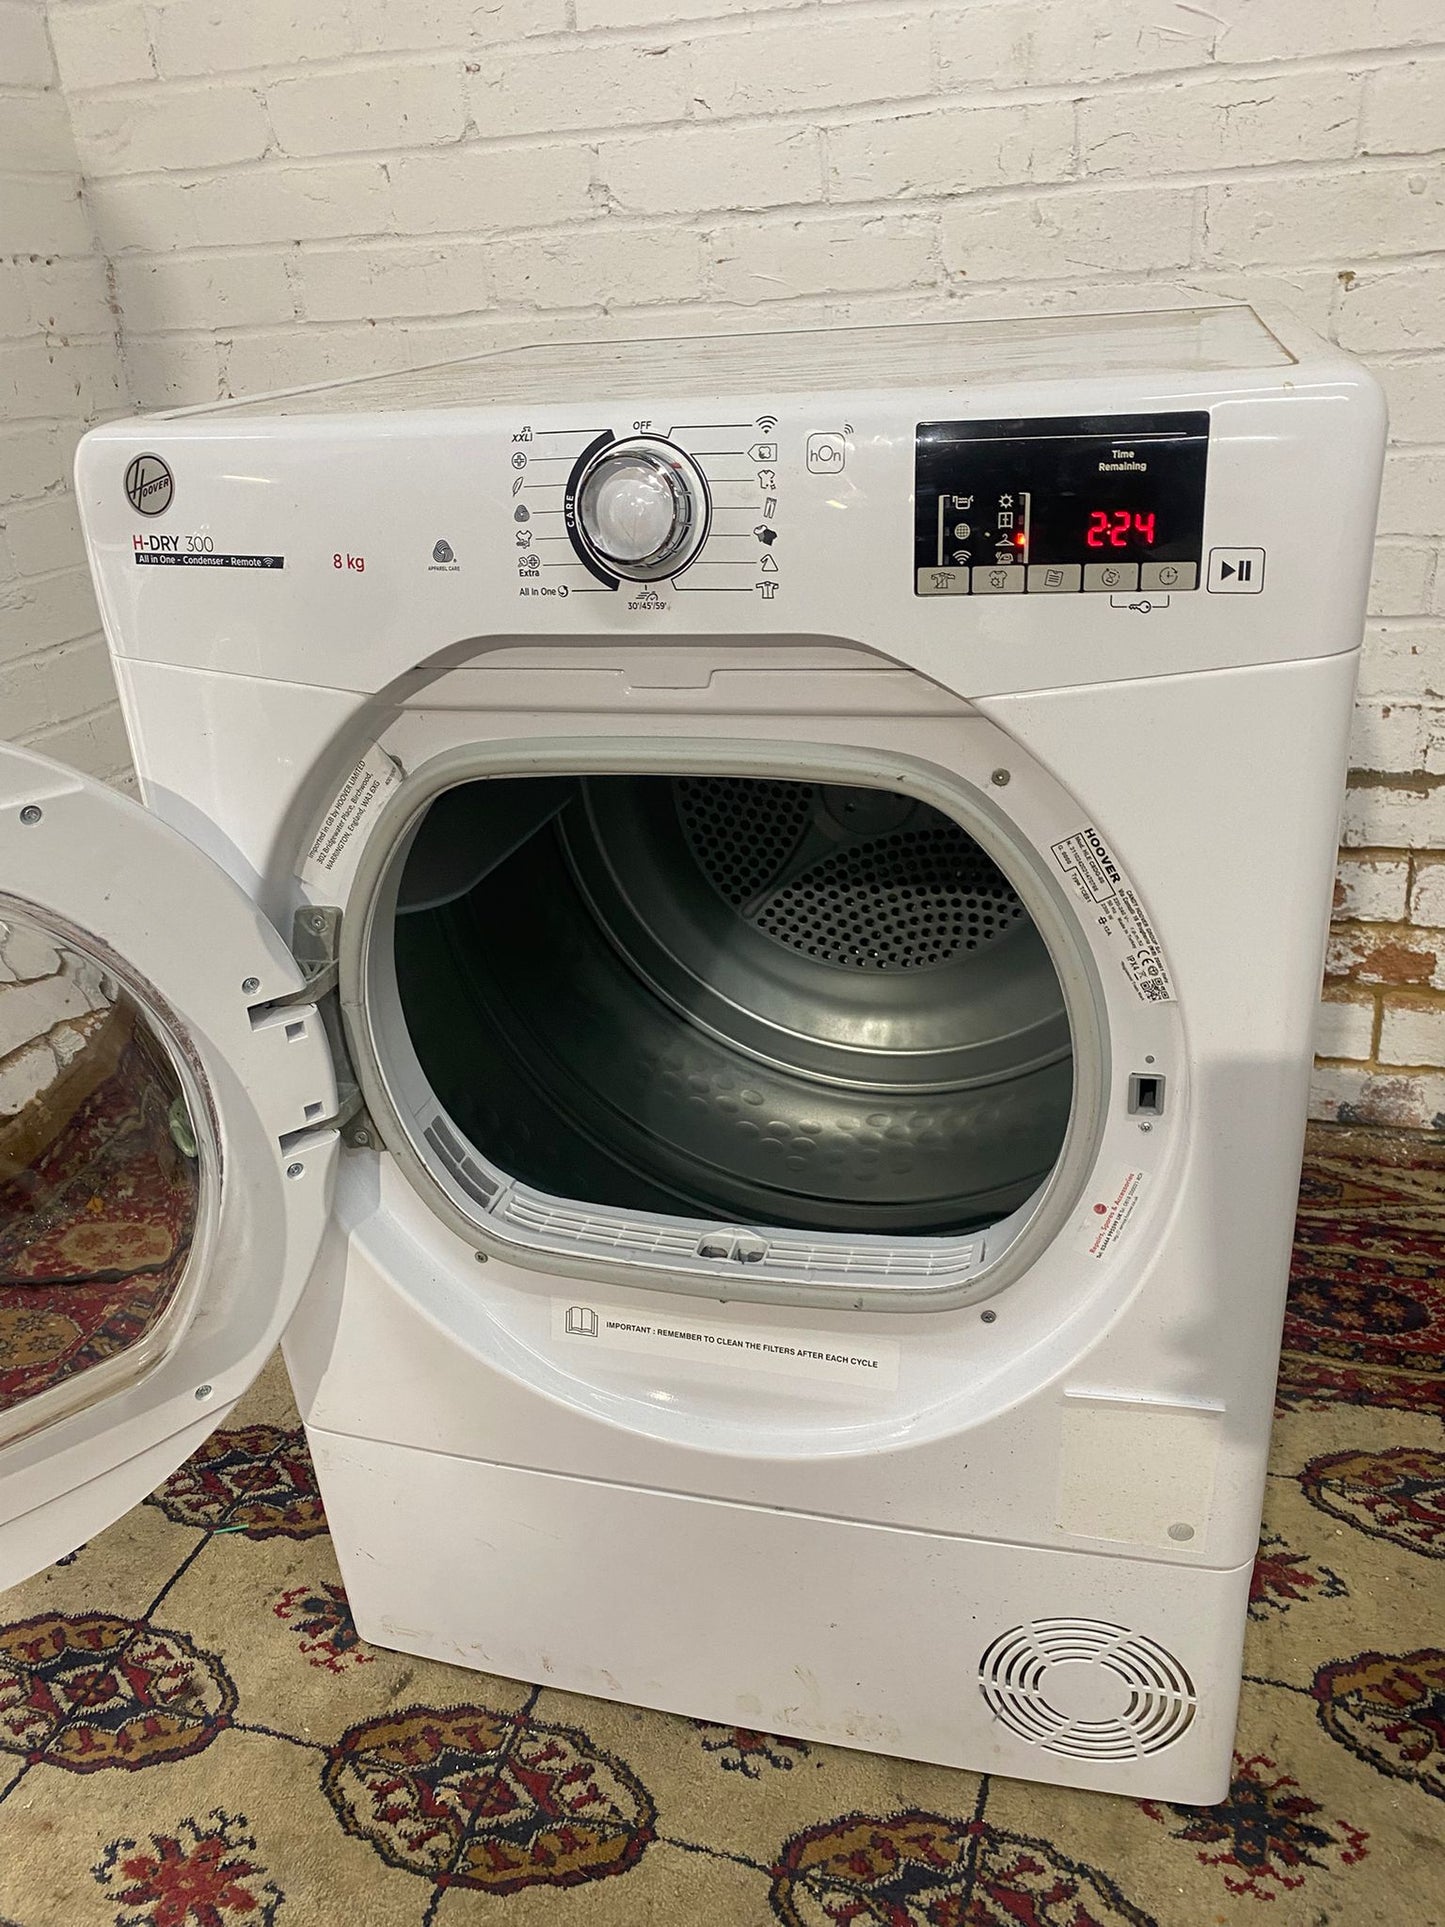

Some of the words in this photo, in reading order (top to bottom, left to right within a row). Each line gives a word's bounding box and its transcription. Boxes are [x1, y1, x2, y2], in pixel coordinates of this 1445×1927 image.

[633, 421, 651, 430] OFF
[512, 434, 530, 442] XXL
[810, 445, 841, 462] hOn
[1112, 450, 1135, 458] Time
[1099, 462, 1147, 471] Remaining
[566, 494, 575, 528] CARE
[1088, 511, 1155, 546] 2:24
[133, 535, 179, 551] H-DRY
[185, 536, 214, 552] 300
[139, 555, 150, 563] All
[160, 556, 175, 564] One
[183, 556, 223, 566] Condenser
[231, 558, 261, 567] Remote
[333, 554, 343, 569] 8
[347, 553, 365, 572] kg
[519, 569, 540, 577] Extra
[519, 587, 530, 596] All
[541, 587, 556, 596] One
[306, 832, 326, 858] Imported
[325, 816, 334, 826] GB
[330, 809, 340, 818] by
[335, 784, 352, 810] HOOVER
[348, 759, 365, 785] LIMITED
[322, 820, 344, 853] Bridgewater
[351, 772, 373, 804] Birchwood,
[325, 832, 352, 870] WARRINGTON,
[347, 808, 366, 832] England,
[361, 792, 373, 807] WA3
[369, 780, 380, 794] 6XG
[1084, 828, 1120, 883] HOOVER
[1072, 873, 1081, 886] Type
[1126, 955, 1139, 971] IPX4
[1089, 1232, 1105, 1253] Repairs,
[1101, 1212, 1115, 1230] Spares
[1114, 1174, 1134, 1205] Accessories
[606, 1322, 651, 1334] IMPORTANT
[657, 1329, 702, 1341] REMEMBER
[717, 1338, 744, 1347] CLEAN
[745, 1342, 761, 1350] THE
[763, 1344, 795, 1355] FILTERS
[797, 1350, 824, 1360] AFTER
[826, 1354, 848, 1363] EACH
[850, 1358, 878, 1368] CYCLE
